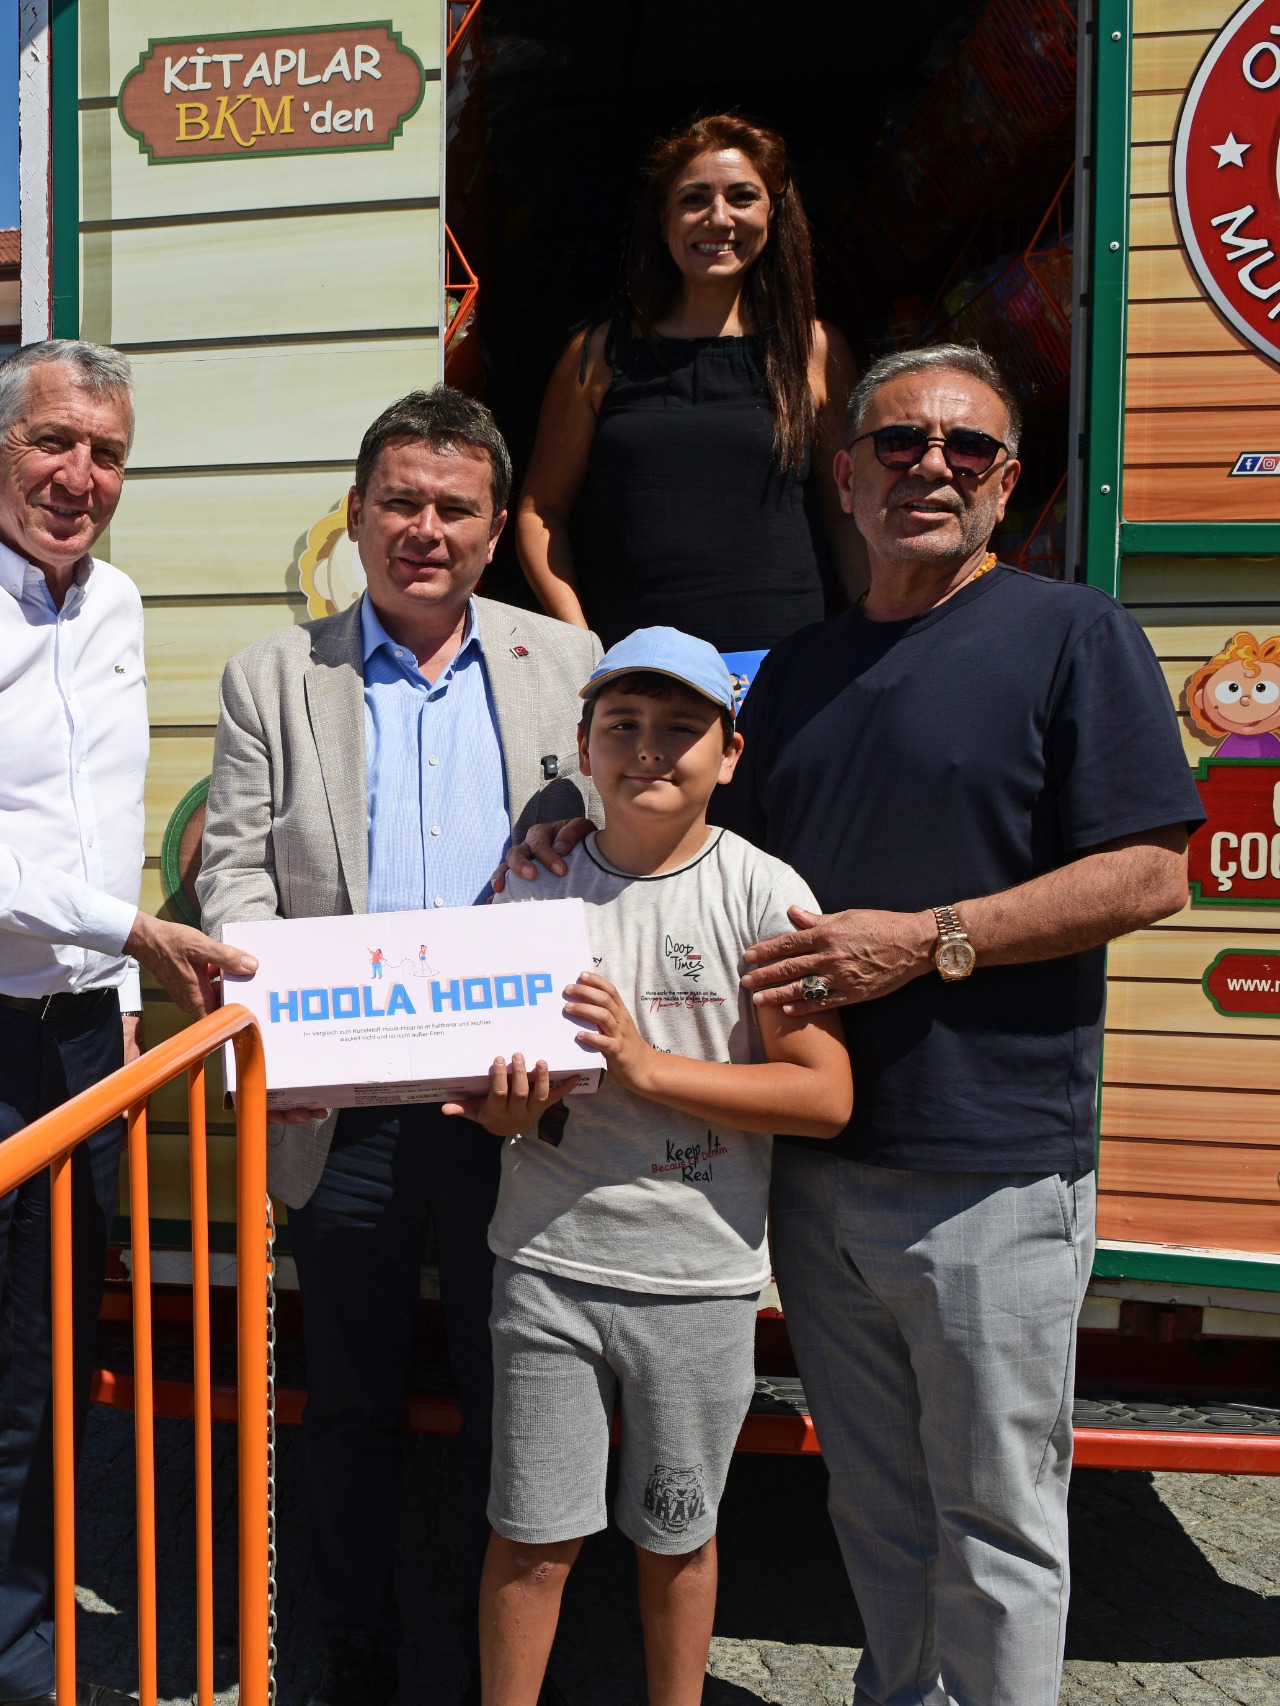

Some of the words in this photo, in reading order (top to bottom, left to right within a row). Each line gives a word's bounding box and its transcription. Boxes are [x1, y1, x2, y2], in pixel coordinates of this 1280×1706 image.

[163, 45, 382, 94] KİTAPLAR
[175, 94, 295, 147] BKM
[267, 983, 417, 1023] HOOLA
[428, 972, 553, 1013] HOOP
[666, 1138, 701, 1168] Keep
[681, 1163, 713, 1183] Real
